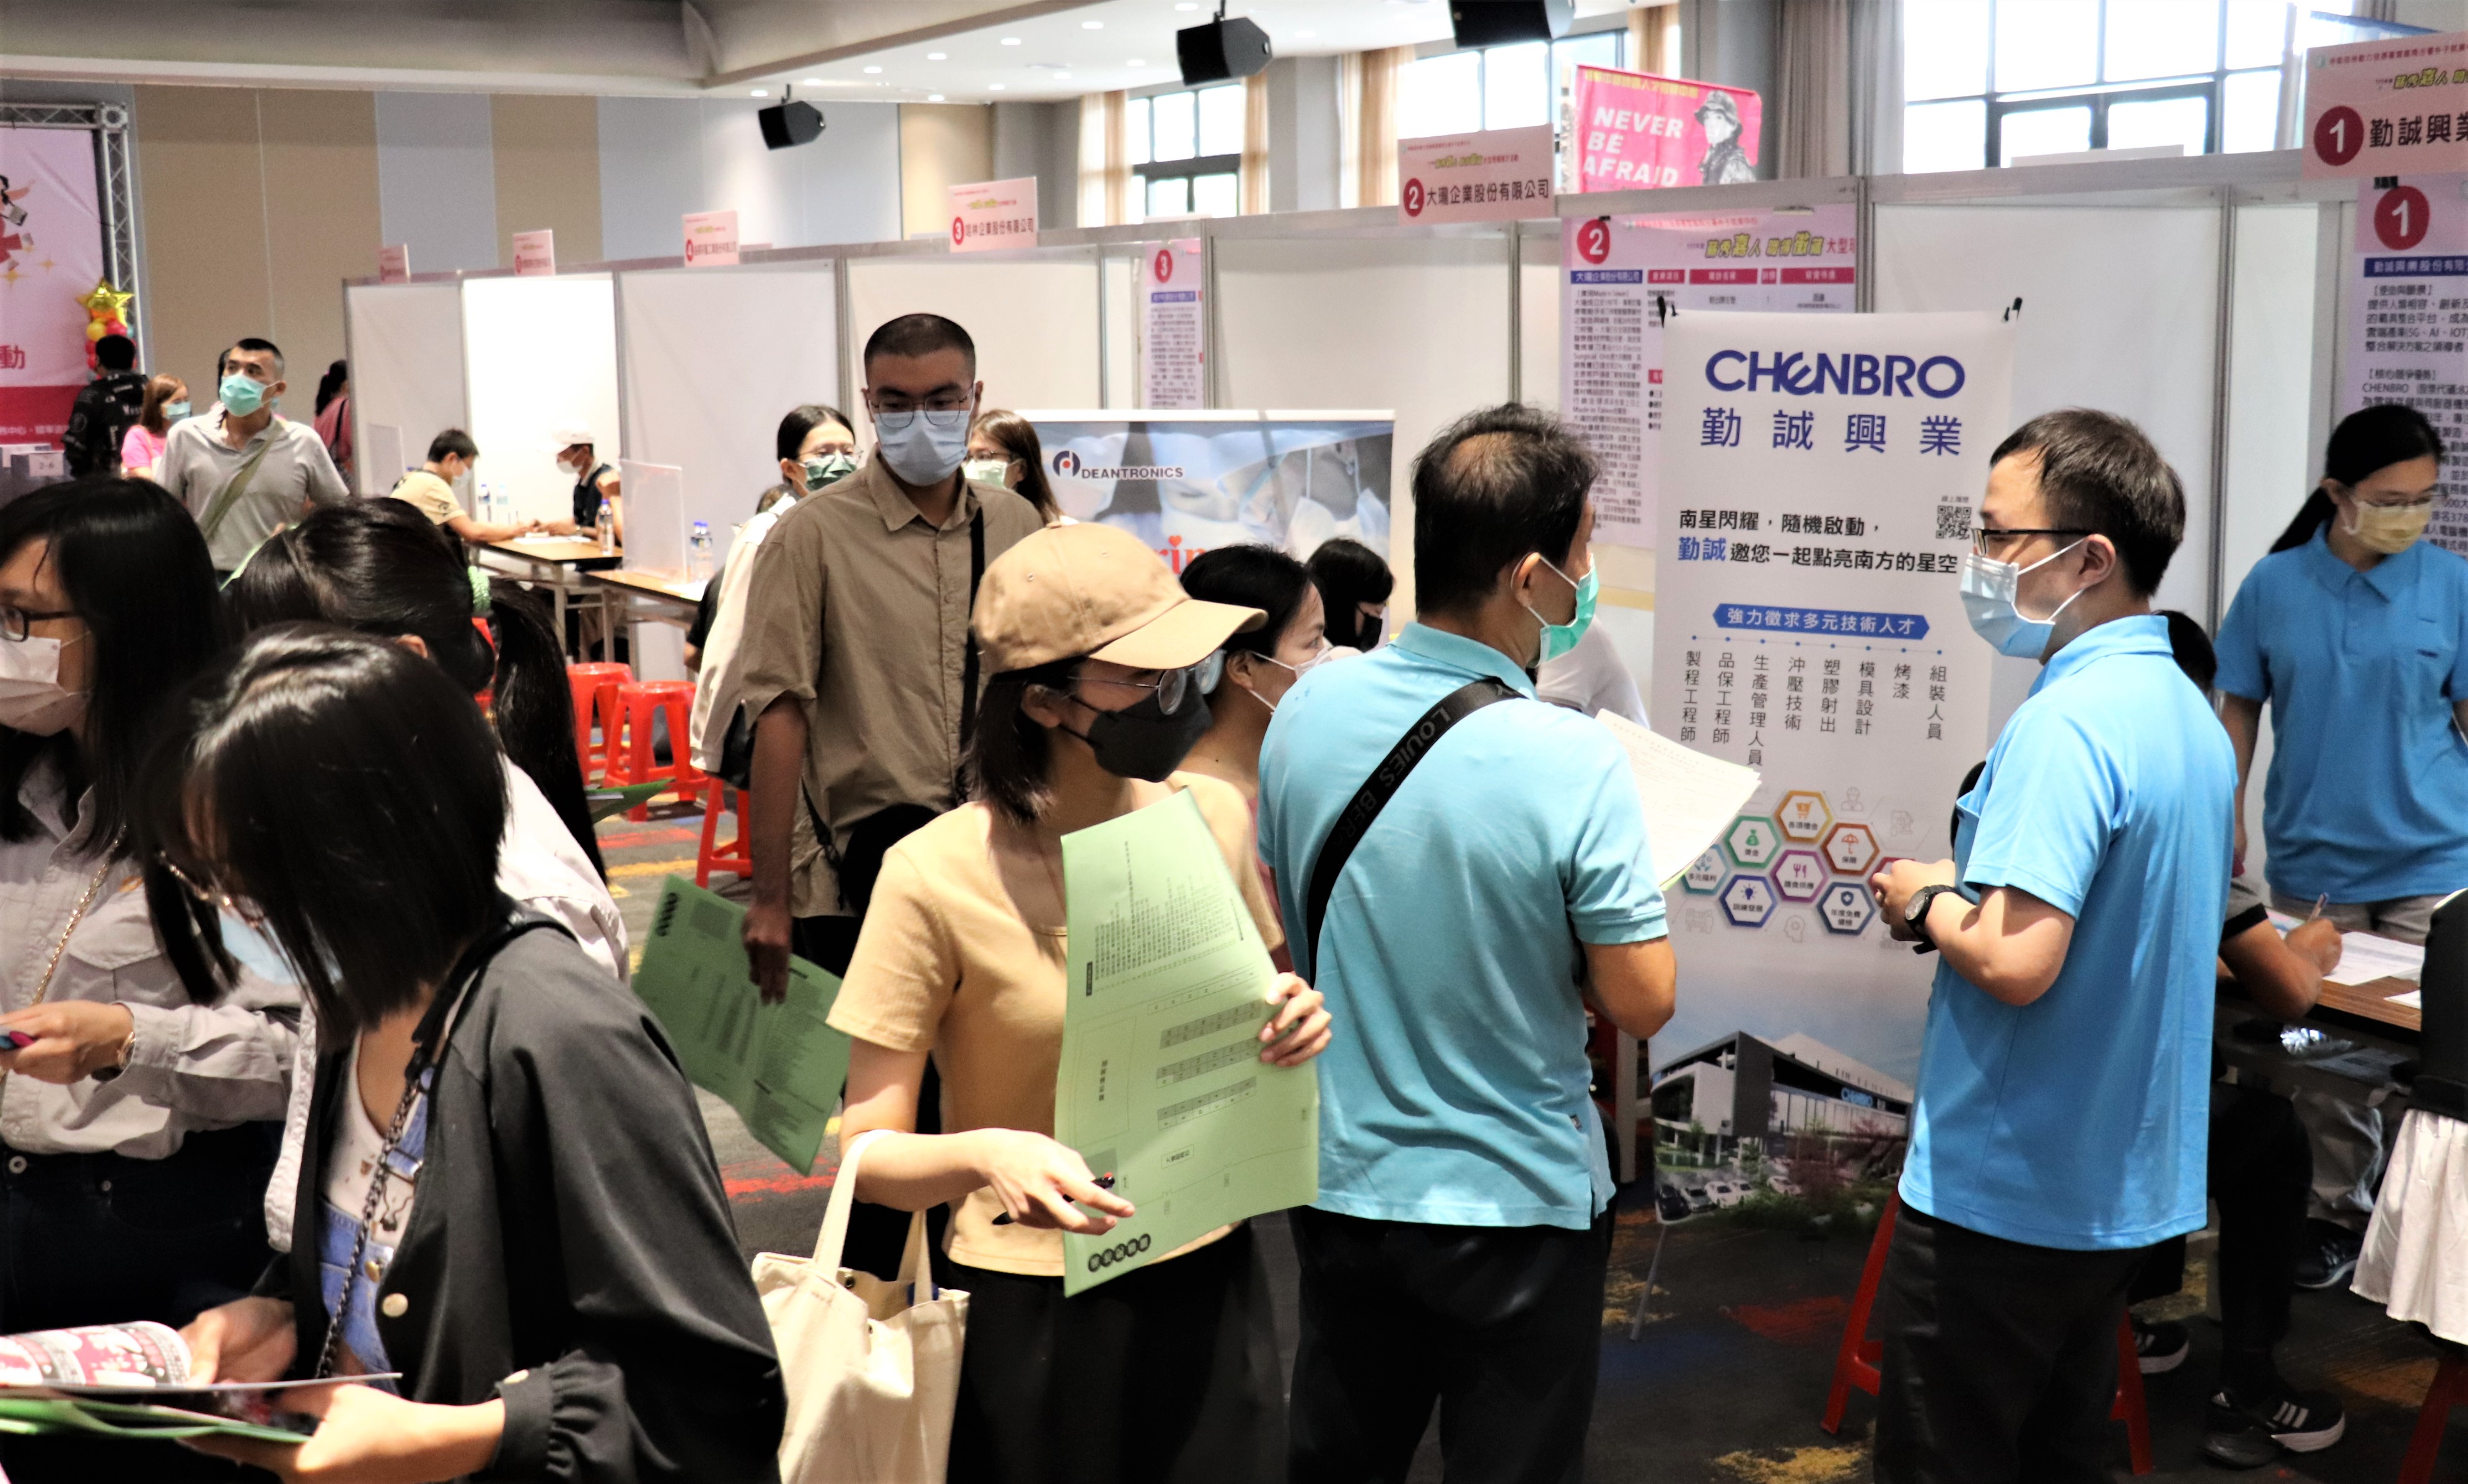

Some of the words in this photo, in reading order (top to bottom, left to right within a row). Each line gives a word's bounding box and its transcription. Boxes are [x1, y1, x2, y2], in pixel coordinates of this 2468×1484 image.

[1593, 107, 1684, 139] NEVER
[2329, 118, 2345, 153] 1
[1587, 132, 1624, 154] BE
[1583, 156, 1678, 186] AFRAID
[1408, 186, 1419, 209] 2
[1427, 179, 1549, 206] 大瓏企業股份有限公司
[955, 222, 962, 240] 3
[2391, 199, 2409, 237] 1
[1589, 229, 1603, 255] 2
[1160, 255, 1168, 277] 3
[2374, 260, 2468, 273] 勤誠興業股份有限
[1705, 349, 1965, 399] CHENBRO
[1700, 407, 1962, 456] 勤誠興業
[1082, 467, 1184, 479] DEANTRONICS
[1679, 508, 1878, 537] 南星閃耀，隨機啟動，
[1727, 608, 1915, 635] 強力徵求多元技術人才
[1680, 650, 1701, 743] 製程工程師
[1712, 652, 1735, 744] 品保工程師
[1785, 657, 1805, 731] 沖壓技術
[1820, 659, 1840, 733] 塑膠射出
[1855, 661, 1876, 736] 模具設計
[1893, 663, 1912, 700] 烤漆
[1746, 655, 1769, 767] 生產管理人員
[1927, 665, 1947, 741] 組裝人員
